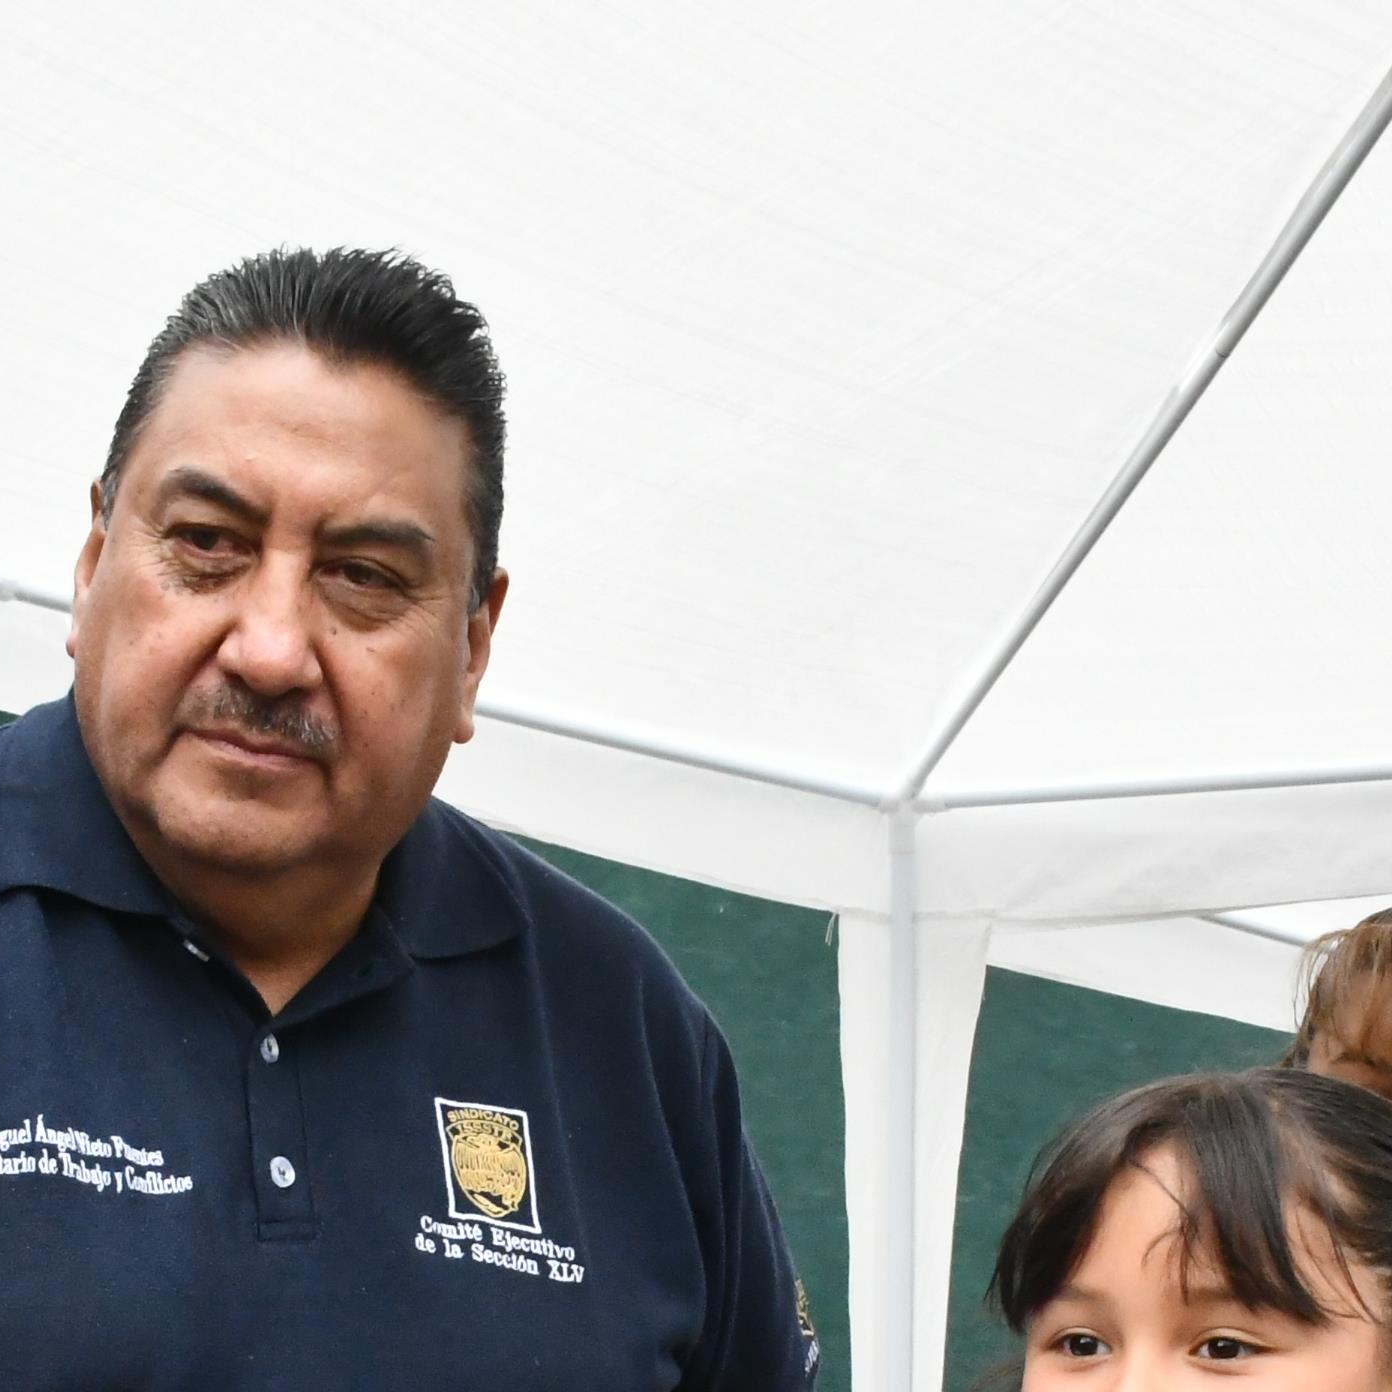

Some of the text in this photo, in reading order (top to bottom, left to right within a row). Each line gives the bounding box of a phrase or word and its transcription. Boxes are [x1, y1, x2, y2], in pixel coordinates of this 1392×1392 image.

[35, 1114, 76, 1152] Ángel
[447, 1109, 519, 1130] SINDICATO
[38, 1149, 58, 1174] de
[58, 1153, 111, 1192] Trabajo
[115, 1171, 123, 1193] y
[125, 1167, 193, 1194] Conflictos
[415, 1233, 584, 1282] de la Sección XLV
[420, 1216, 575, 1260] Comité Ejecutivo
